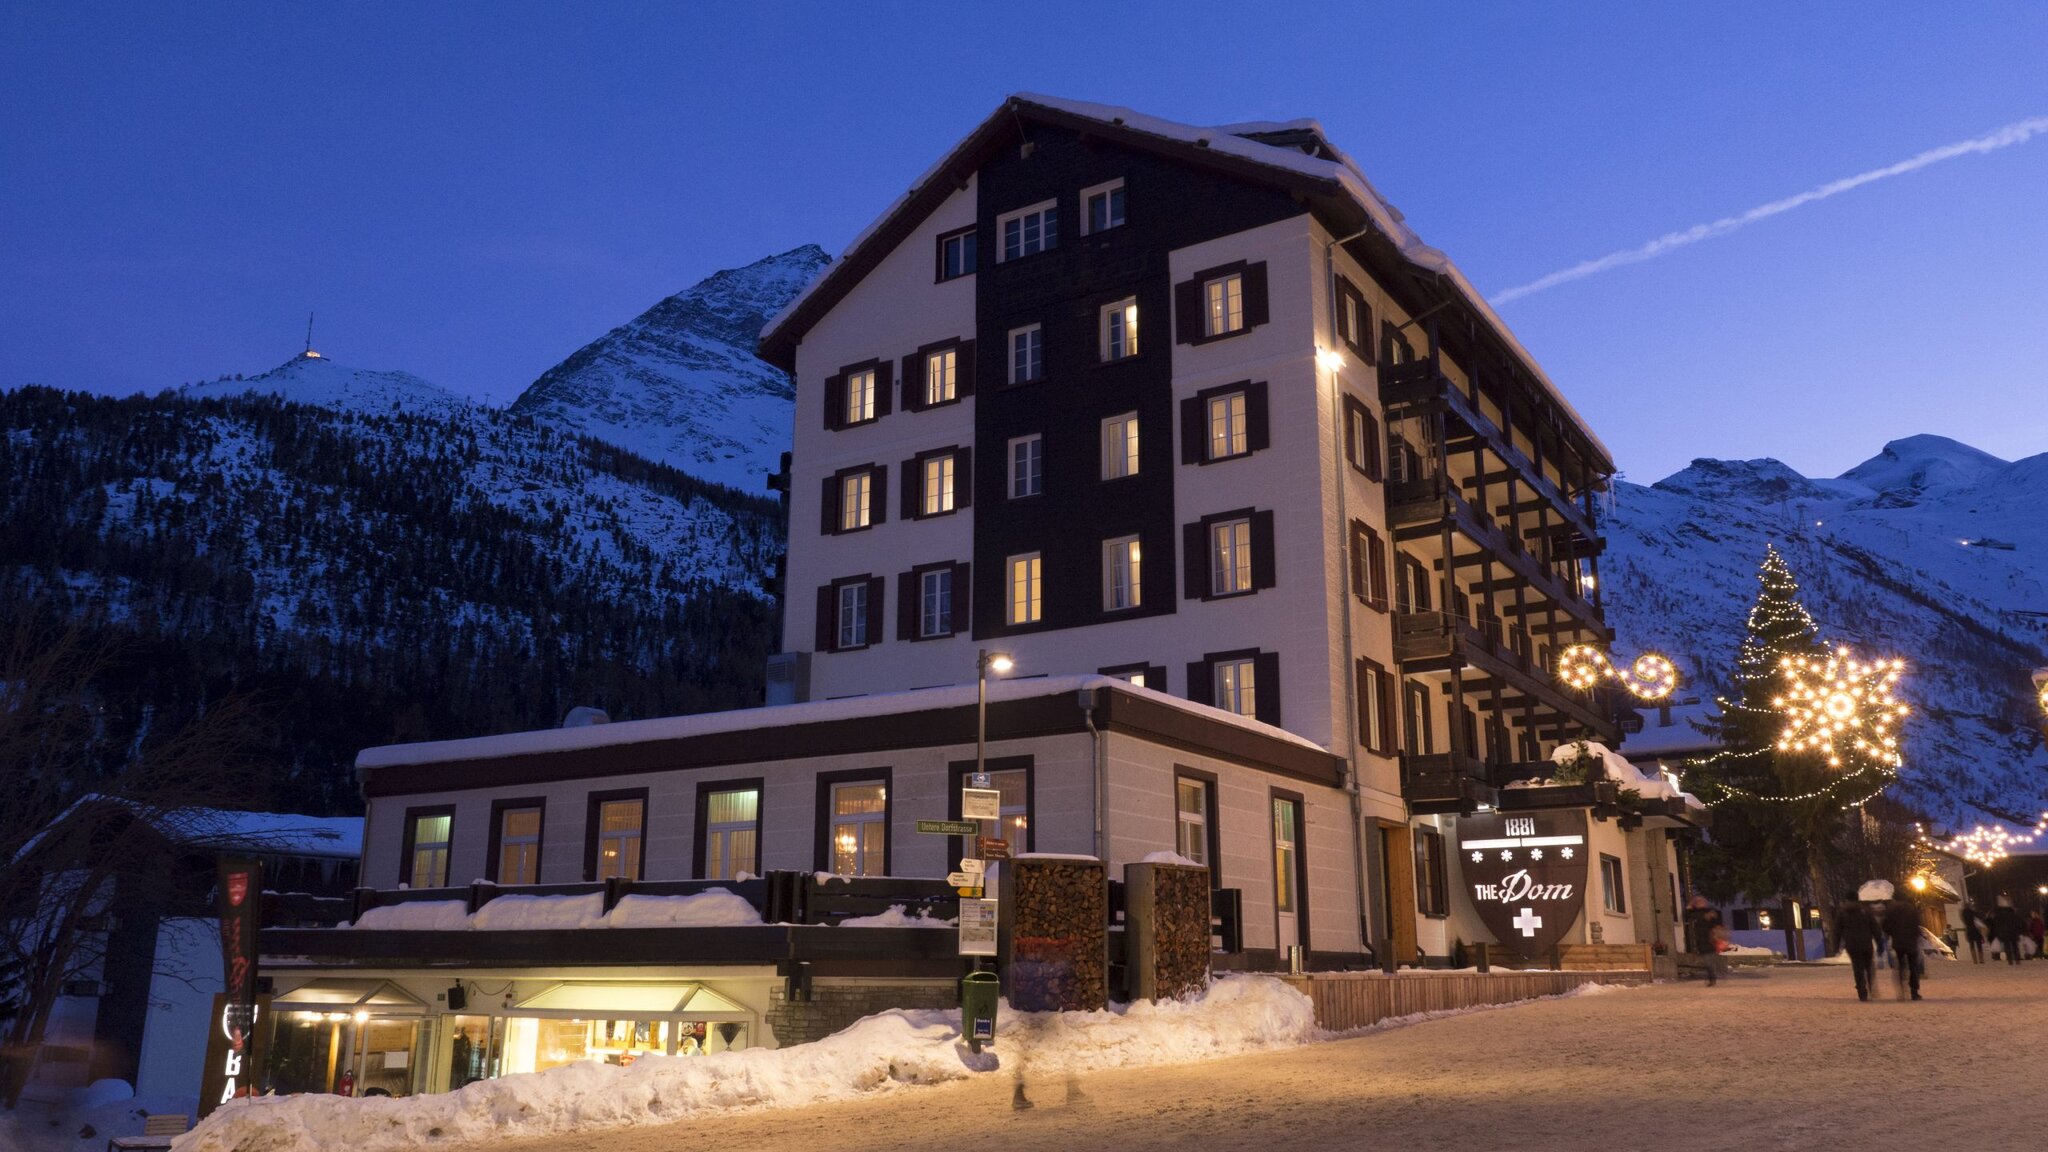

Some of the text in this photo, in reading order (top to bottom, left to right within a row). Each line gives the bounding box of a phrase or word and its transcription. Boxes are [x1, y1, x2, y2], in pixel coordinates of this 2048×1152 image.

[921, 822, 973, 833] Untere Dorfstrasse
[1505, 817, 1535, 837] 1881
[1475, 869, 1573, 904] THE Dom
